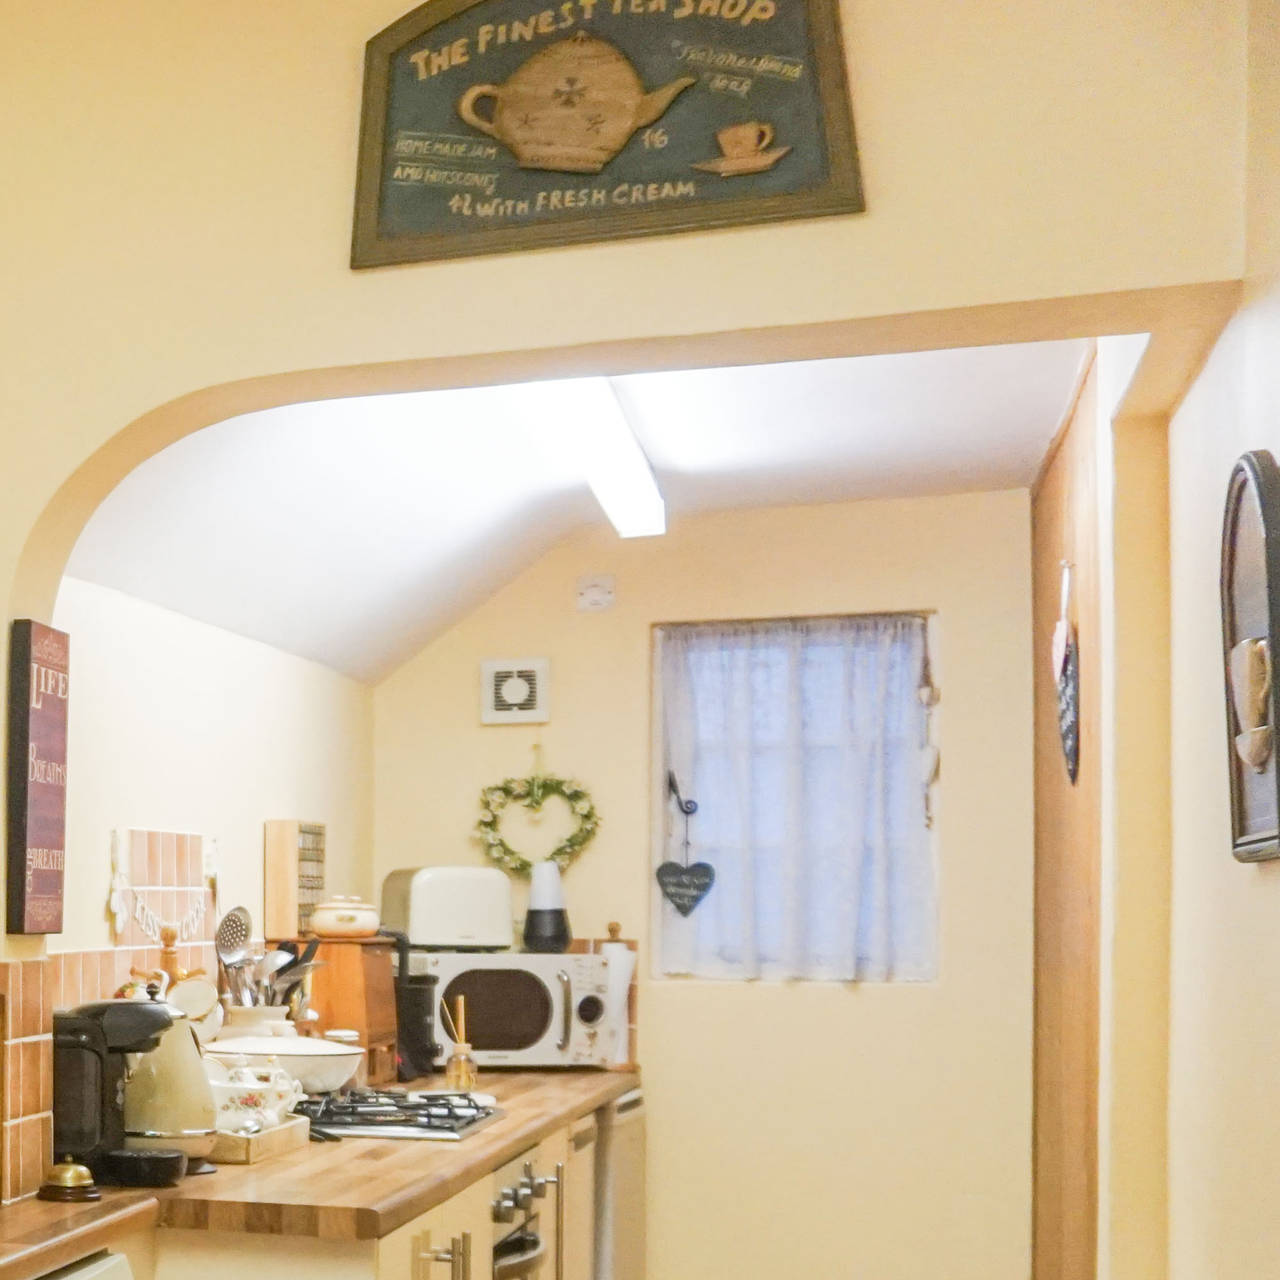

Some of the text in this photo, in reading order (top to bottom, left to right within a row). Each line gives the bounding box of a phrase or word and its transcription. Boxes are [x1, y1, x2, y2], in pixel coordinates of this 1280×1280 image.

[409, 38, 470, 81] THE
[477, 1, 595, 53] FINEST
[536, 188, 606, 211] FRESH
[612, 181, 696, 205] CREAM
[31, 662, 68, 709] LIFE
